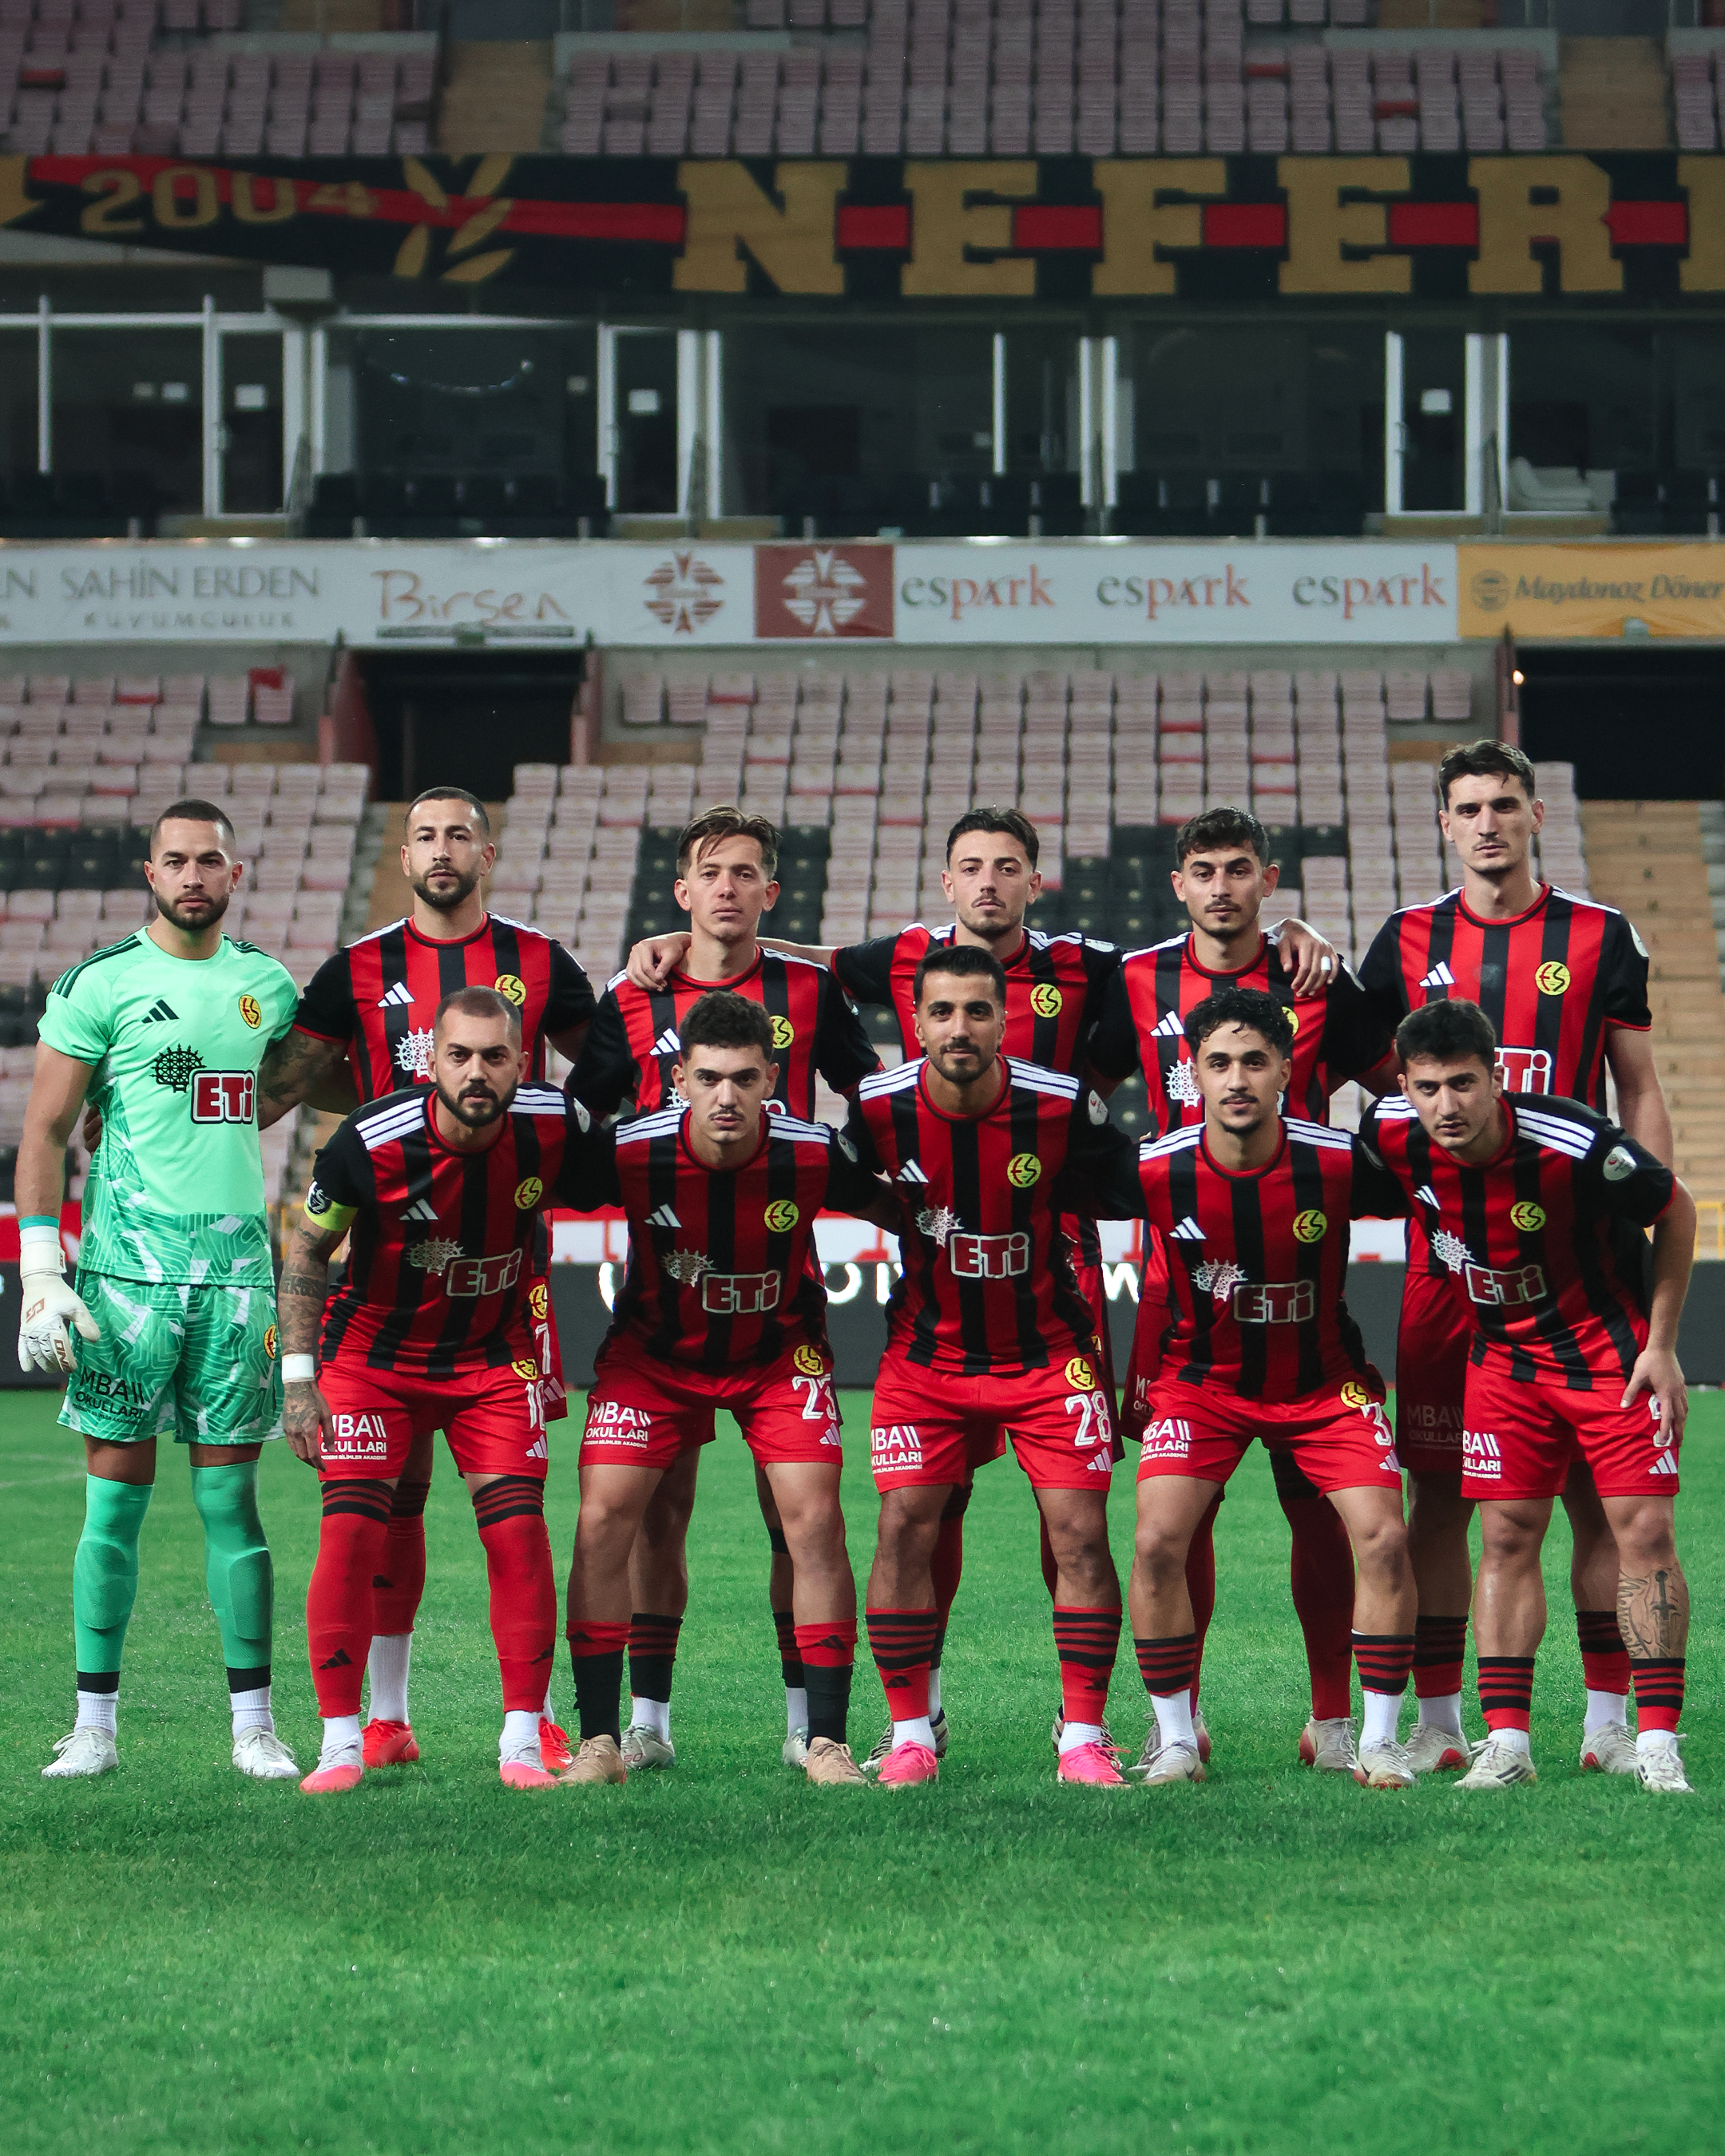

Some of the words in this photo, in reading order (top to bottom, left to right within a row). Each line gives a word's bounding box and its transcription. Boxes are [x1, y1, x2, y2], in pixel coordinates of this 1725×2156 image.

[193, 565, 320, 599] ERDEN
[371, 569, 572, 622] Birsen
[900, 564, 1056, 620] espark
[1096, 564, 1251, 620] espark
[1291, 563, 1447, 619] espark
[1494, 1047, 1552, 1093] Ti
[76, 1391, 144, 1419] OKULLARI
[1065, 1390, 1112, 1447] 28
[585, 1426, 648, 1442] OKULLARI
